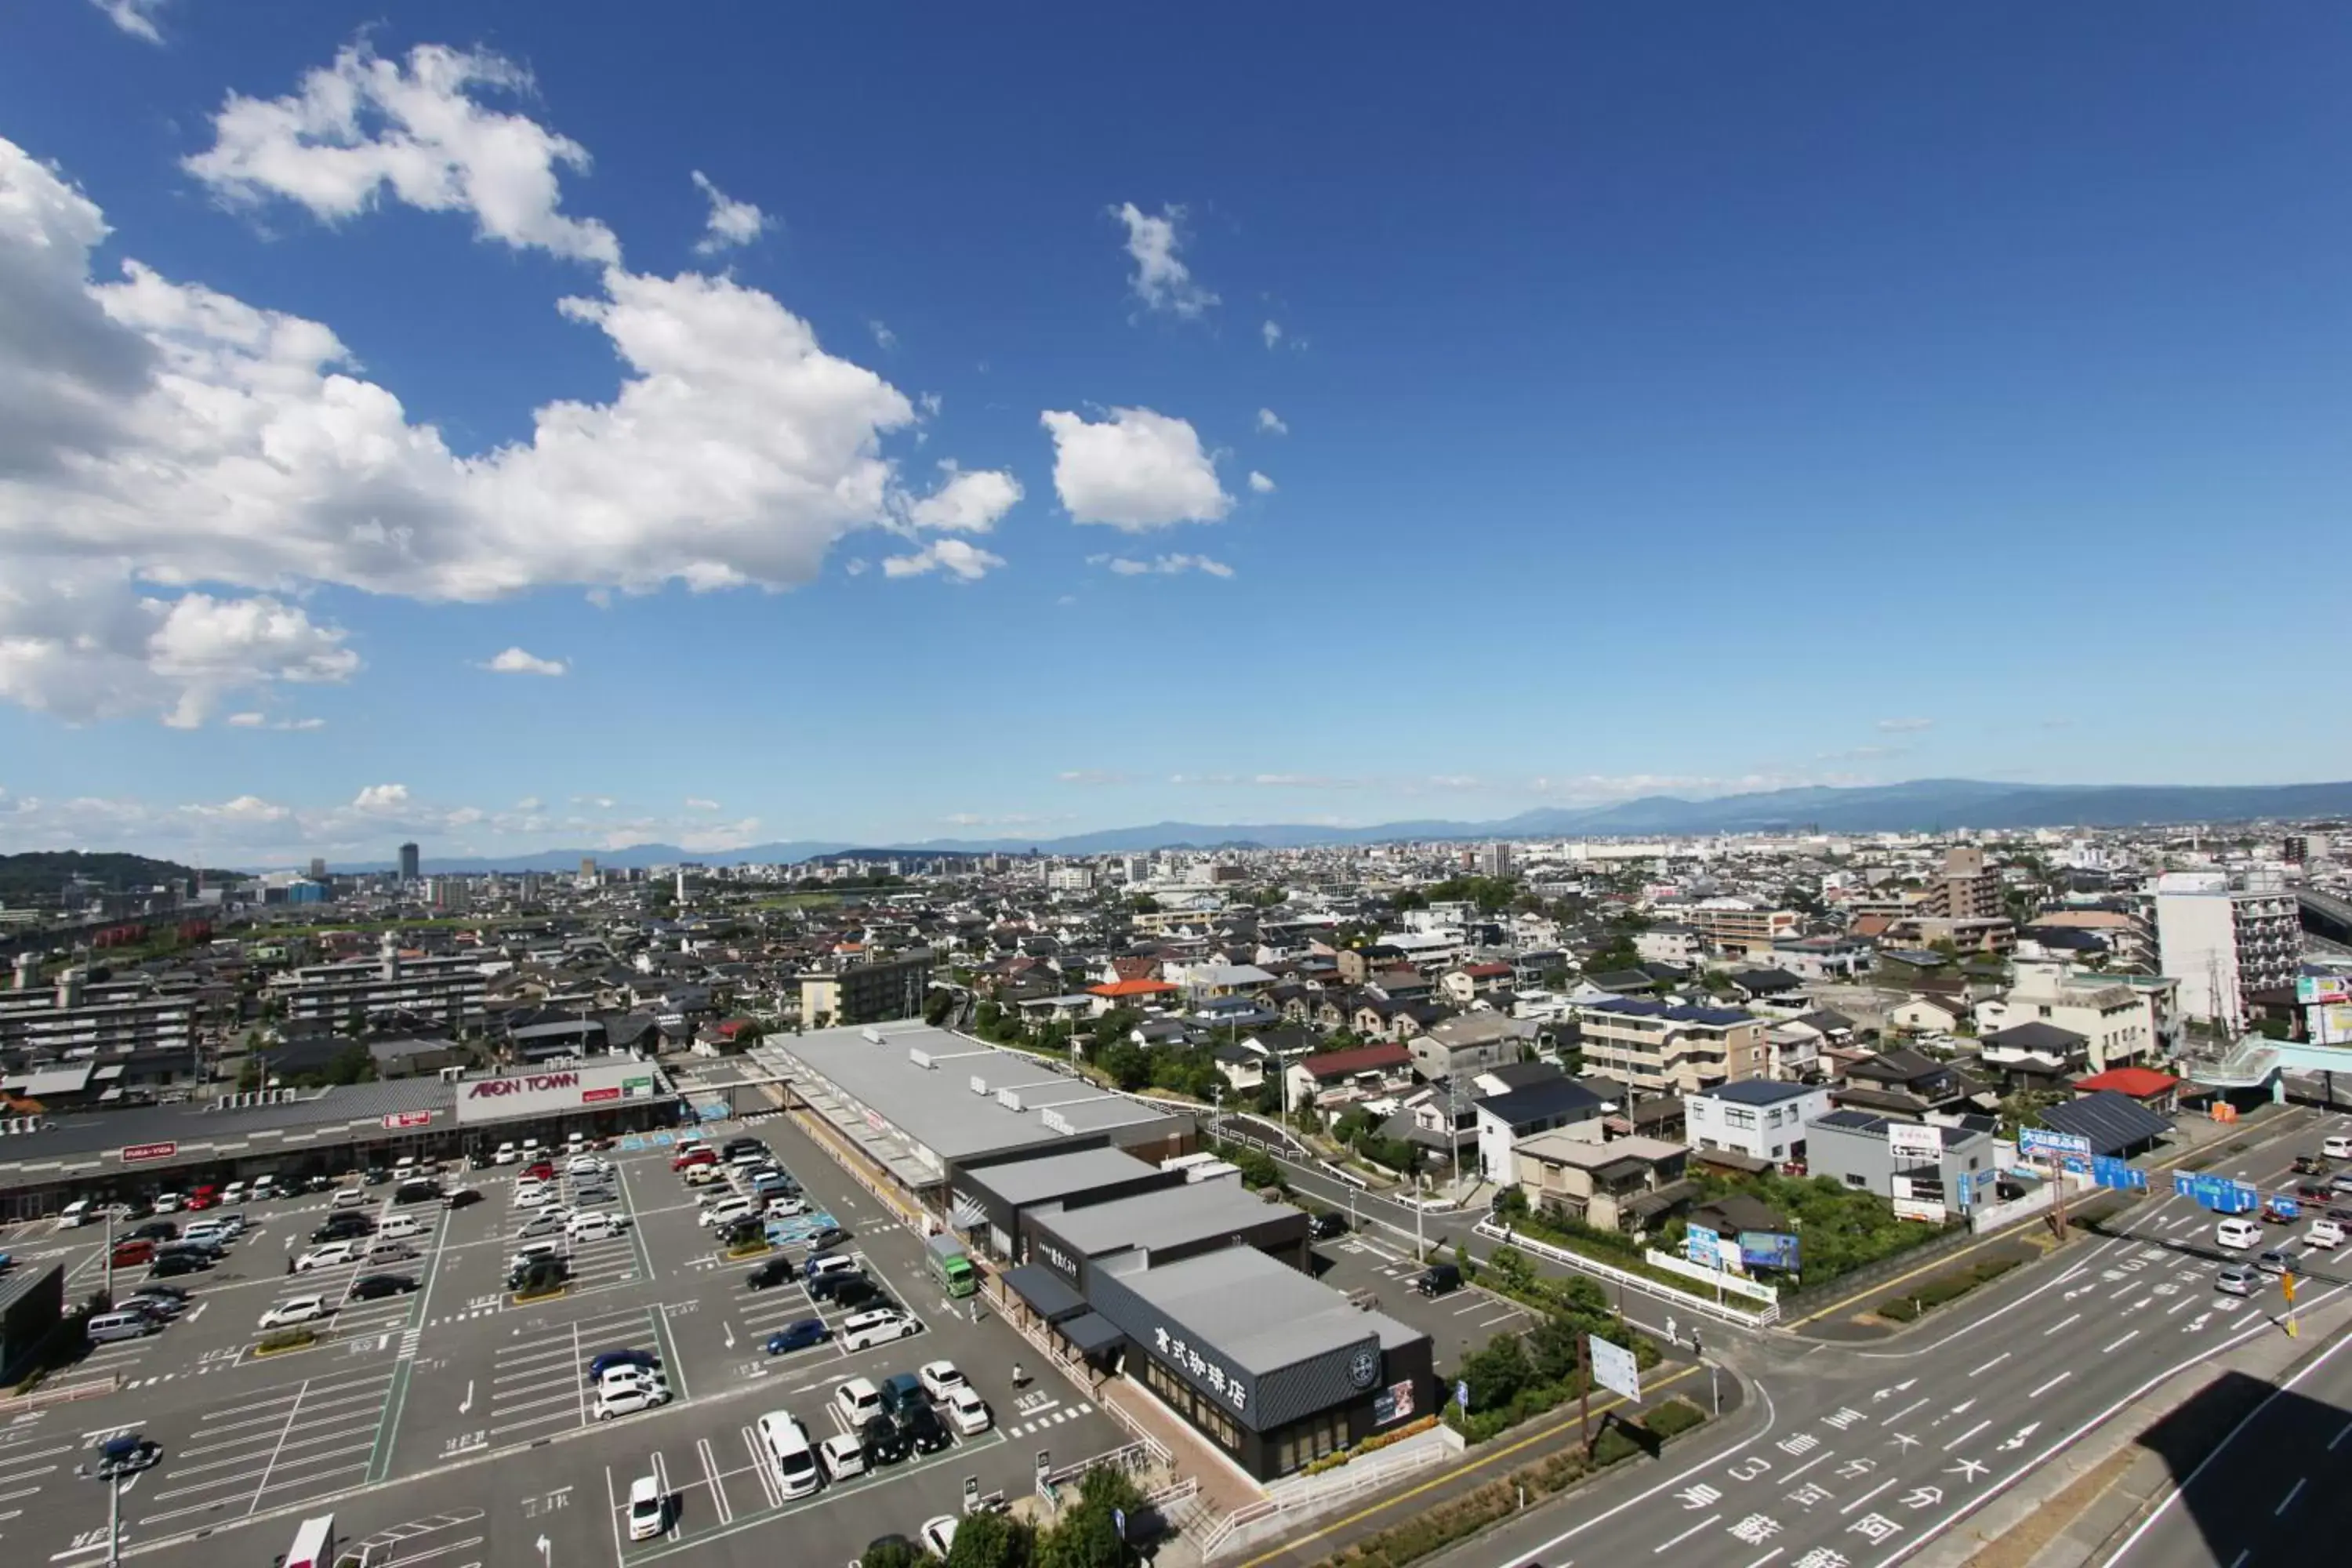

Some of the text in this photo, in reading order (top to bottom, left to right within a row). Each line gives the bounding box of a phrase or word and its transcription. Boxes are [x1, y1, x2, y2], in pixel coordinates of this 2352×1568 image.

[526, 1073, 579, 1092] TOWN
[1155, 1327, 1246, 1410] 倉式珈琲店
